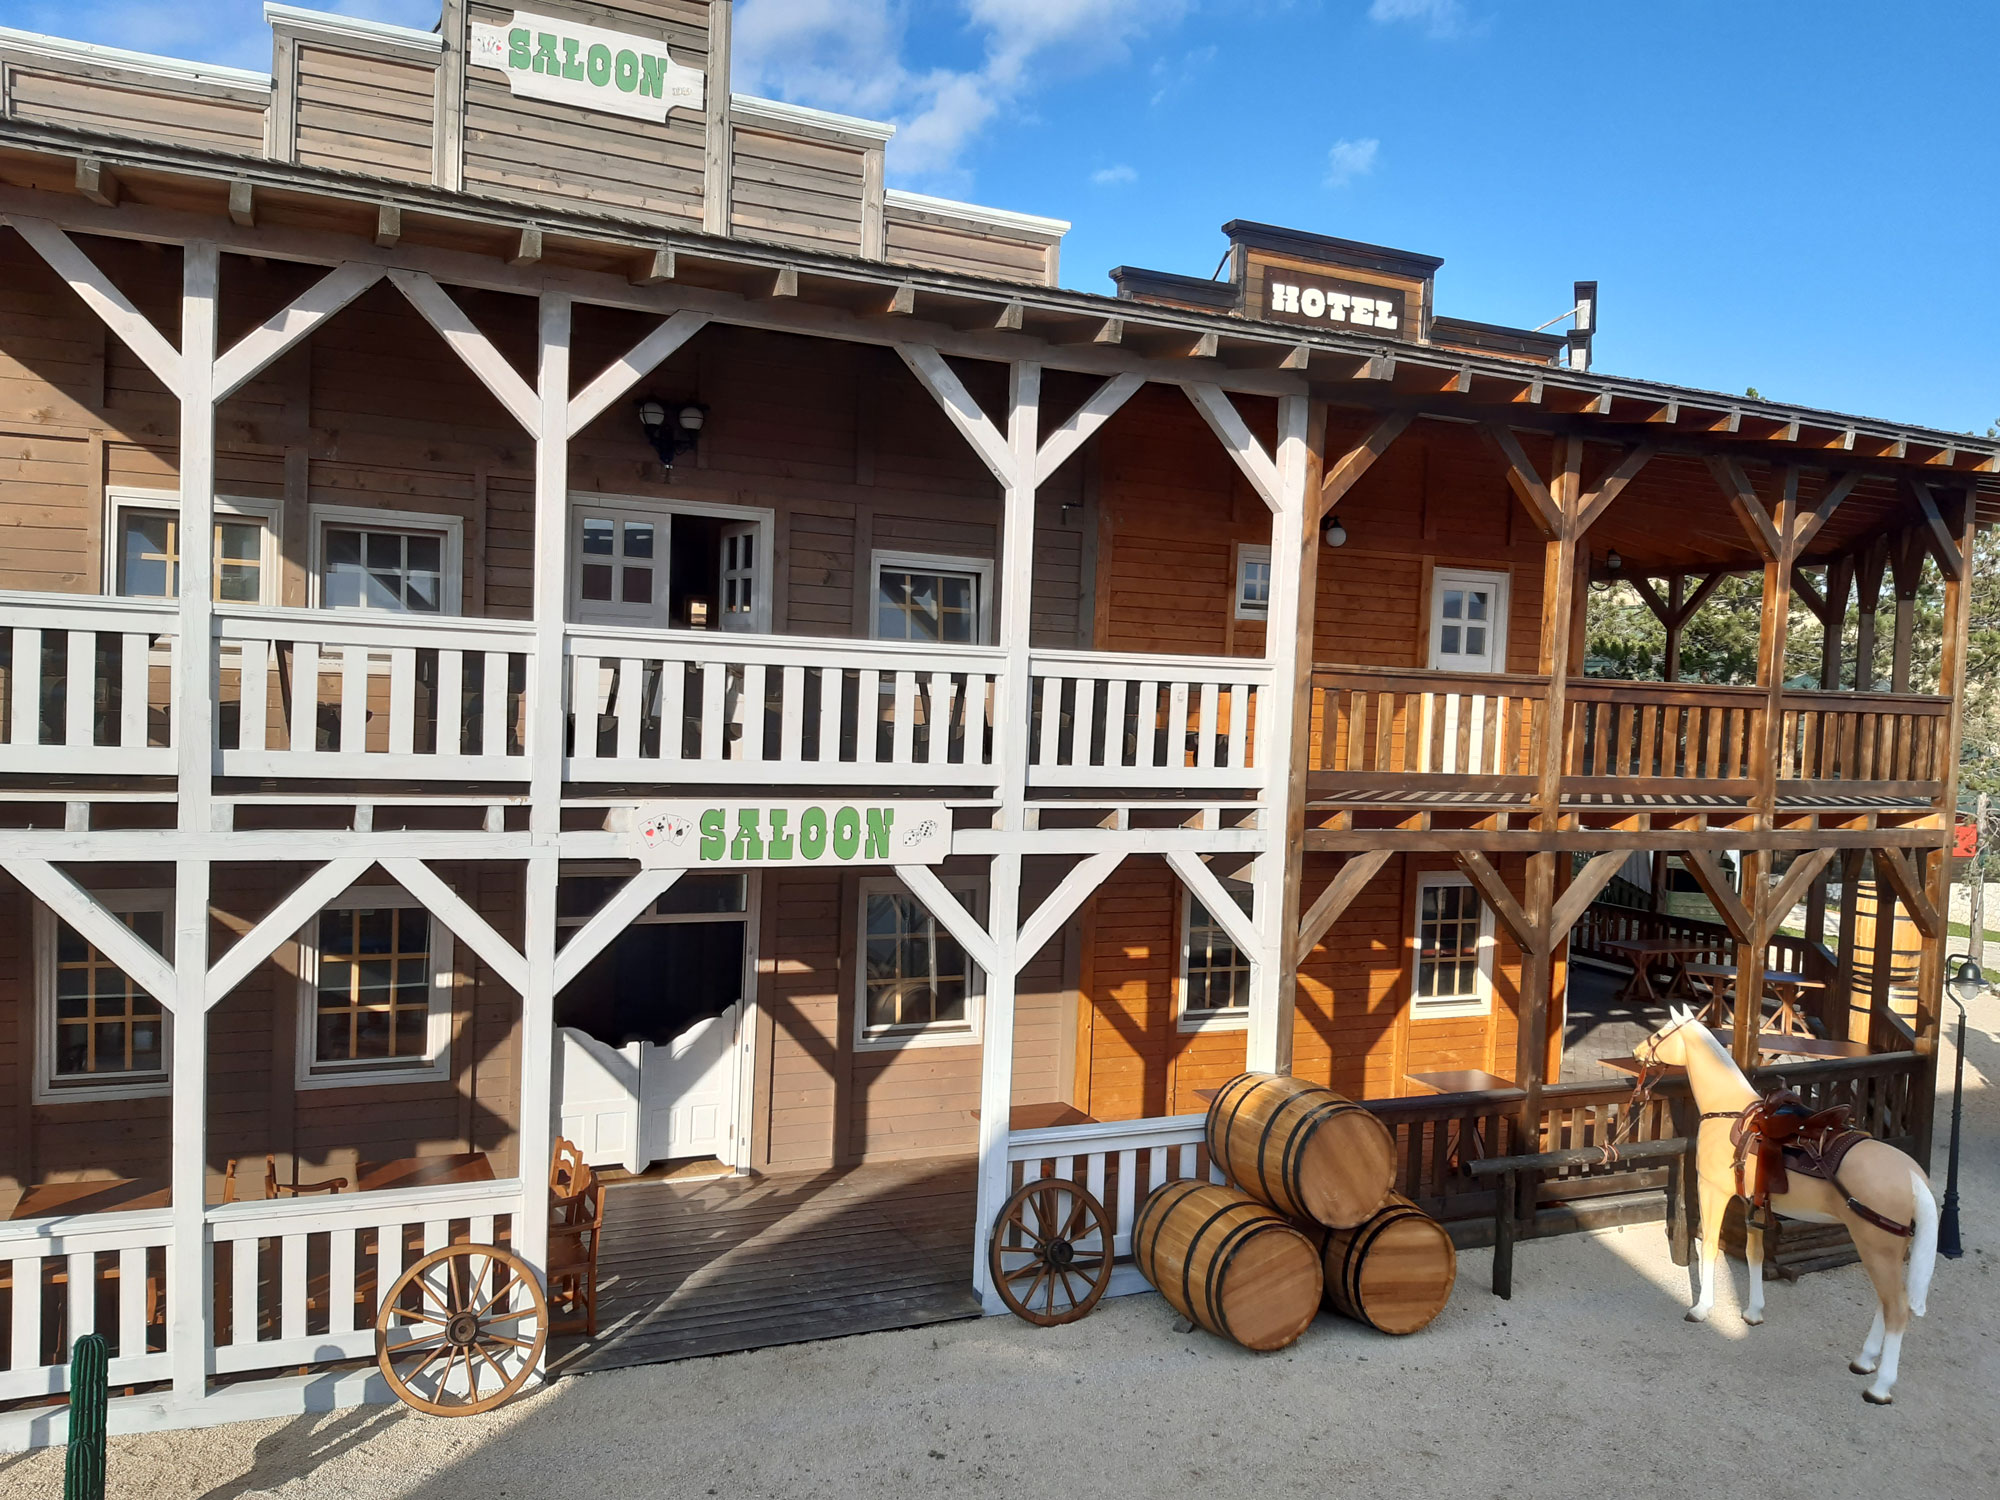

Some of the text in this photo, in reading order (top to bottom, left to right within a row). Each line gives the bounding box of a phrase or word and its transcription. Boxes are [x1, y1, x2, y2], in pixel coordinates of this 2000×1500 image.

[508, 28, 668, 99] SALOON
[1271, 283, 1398, 330] HOTEL
[699, 806, 894, 861] SALOON
